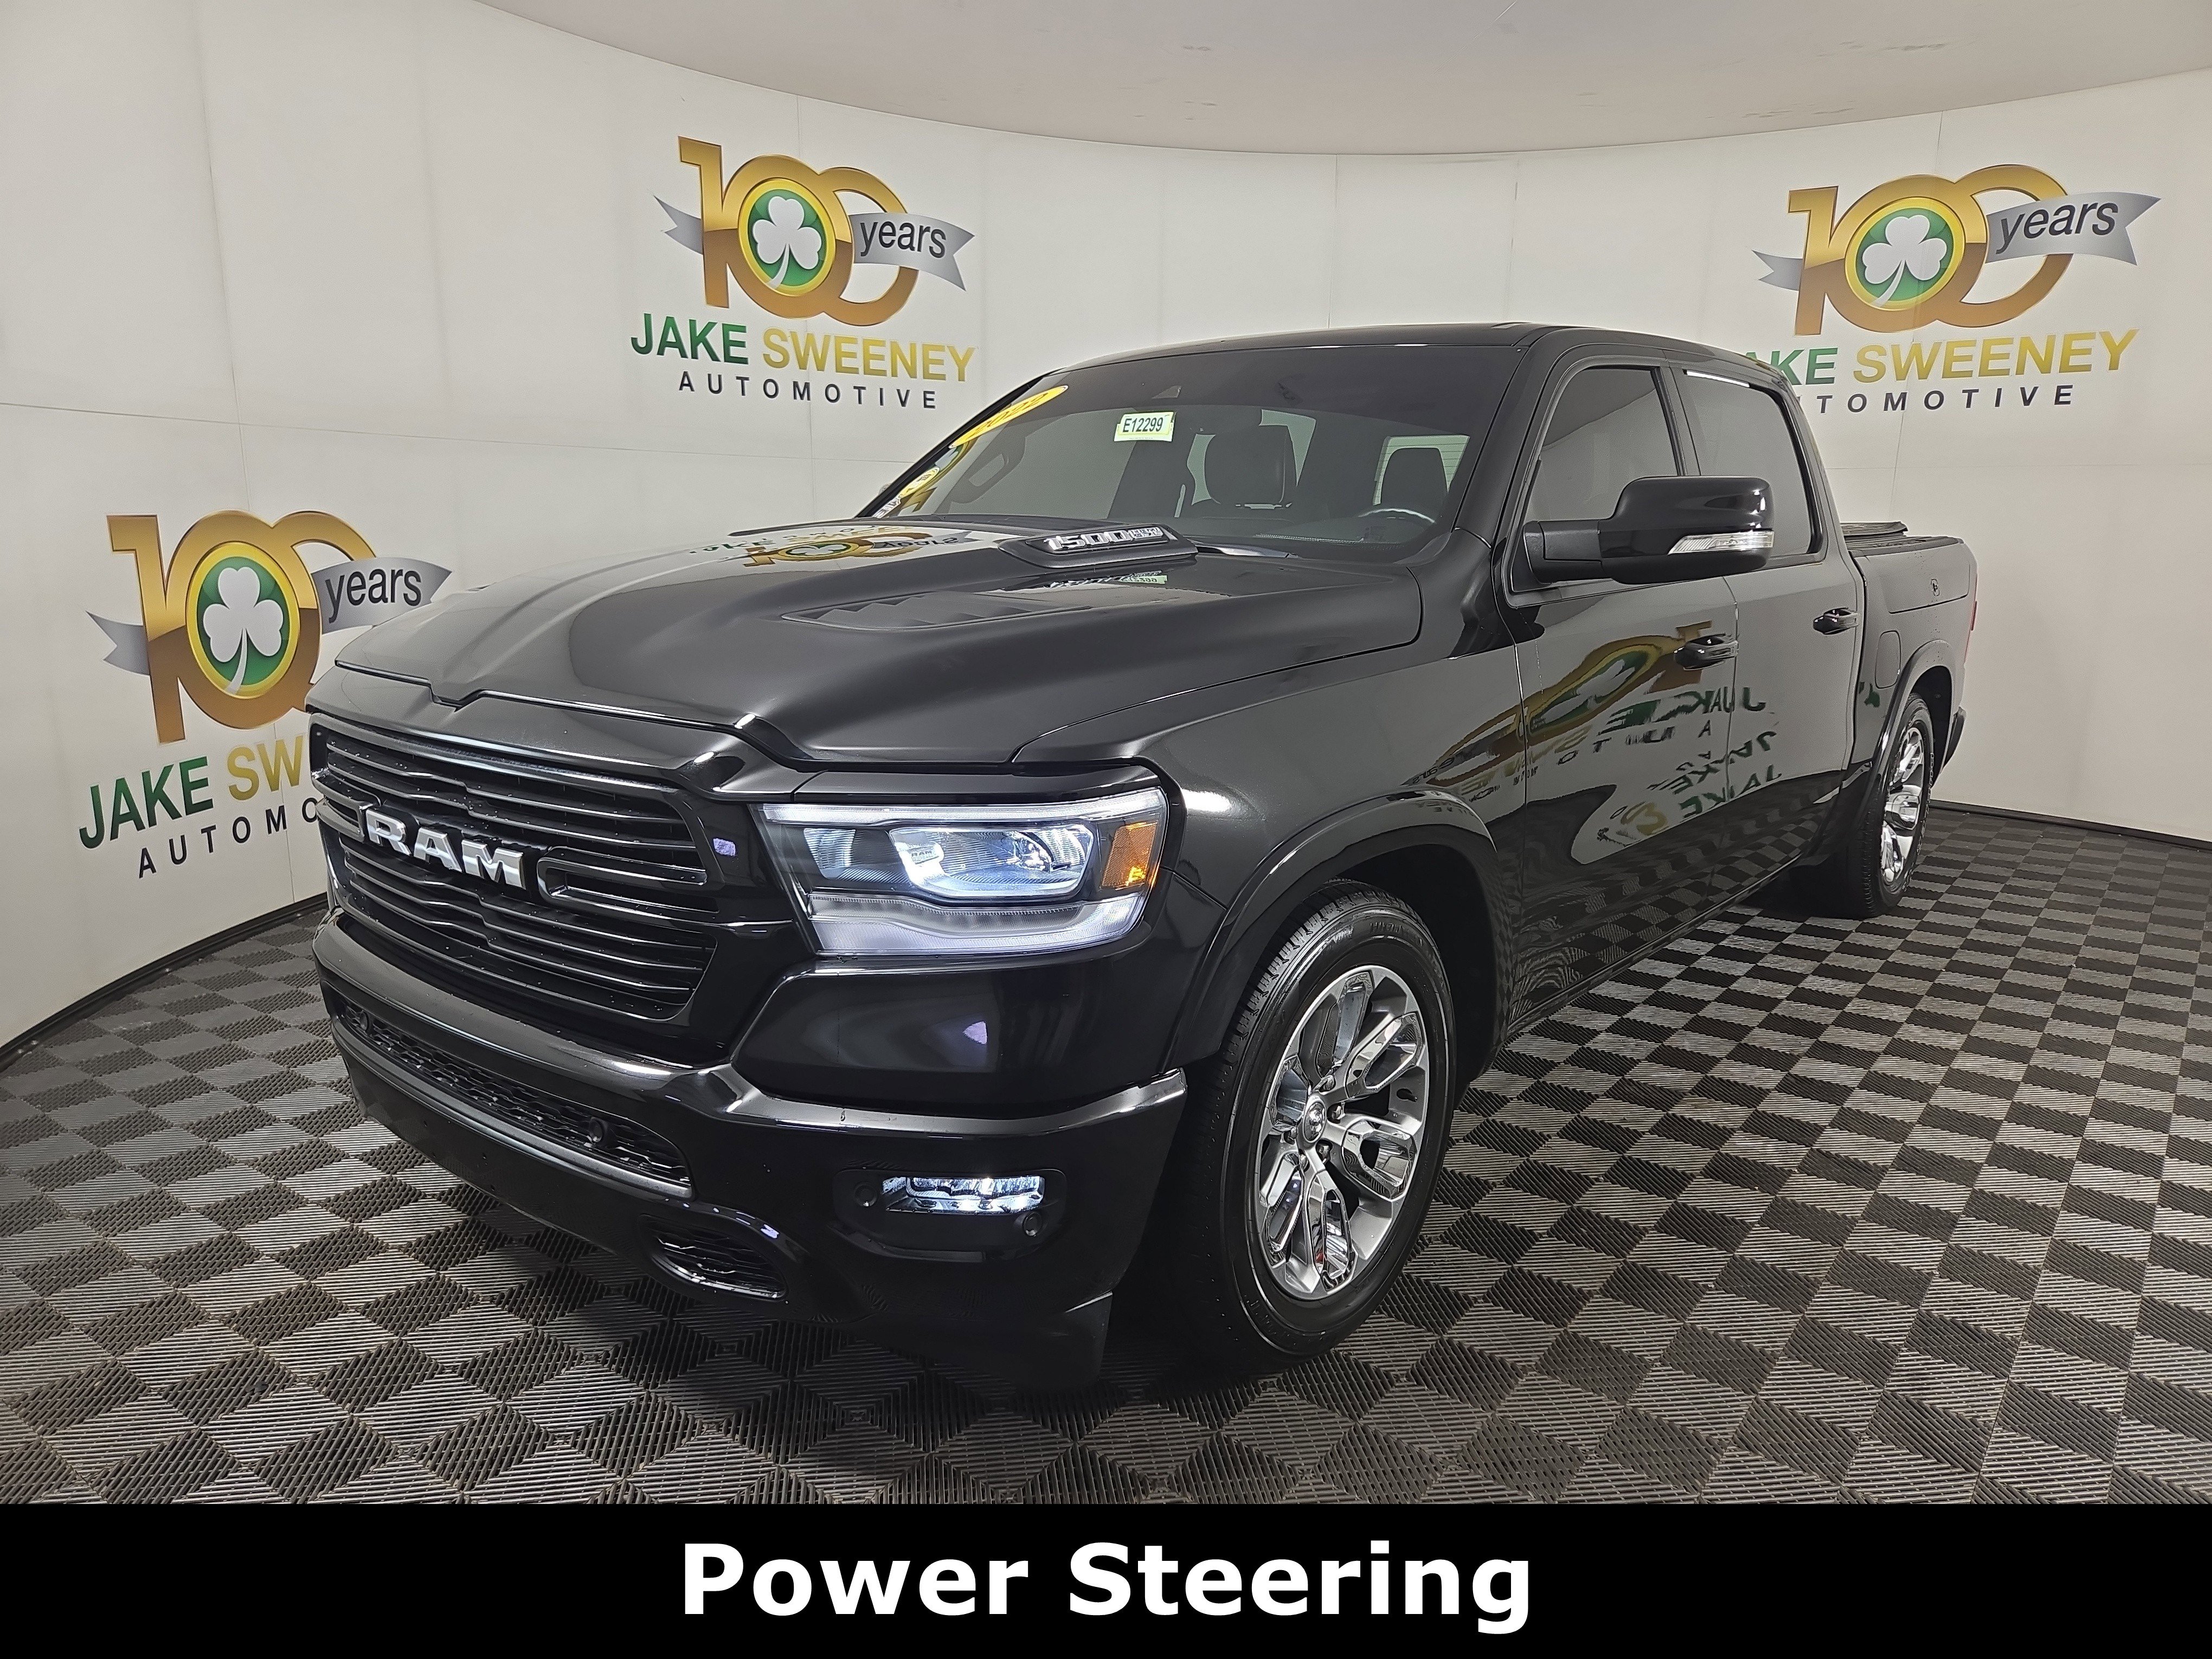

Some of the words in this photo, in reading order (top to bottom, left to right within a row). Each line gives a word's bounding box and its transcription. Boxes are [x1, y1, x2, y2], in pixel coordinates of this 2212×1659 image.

[678, 136, 920, 326] 100
[859, 221, 947, 259] years
[1787, 164, 2074, 336] 100
[1996, 202, 2118, 254] years
[631, 312, 749, 364] JAKE
[762, 328, 975, 382] SWEENEY
[1745, 347, 1838, 385] KE
[1853, 327, 2139, 383] SWEENEY
[679, 371, 936, 409] AUTOMOTIVE
[1797, 384, 2074, 414] TOMOTIVE
[1122, 417, 1163, 433] E12299
[1043, 529, 1134, 550] 1500
[325, 568, 422, 623] years
[79, 756, 214, 849] JAKE
[138, 797, 318, 879] AUTOMO
[365, 808, 526, 890] RAM
